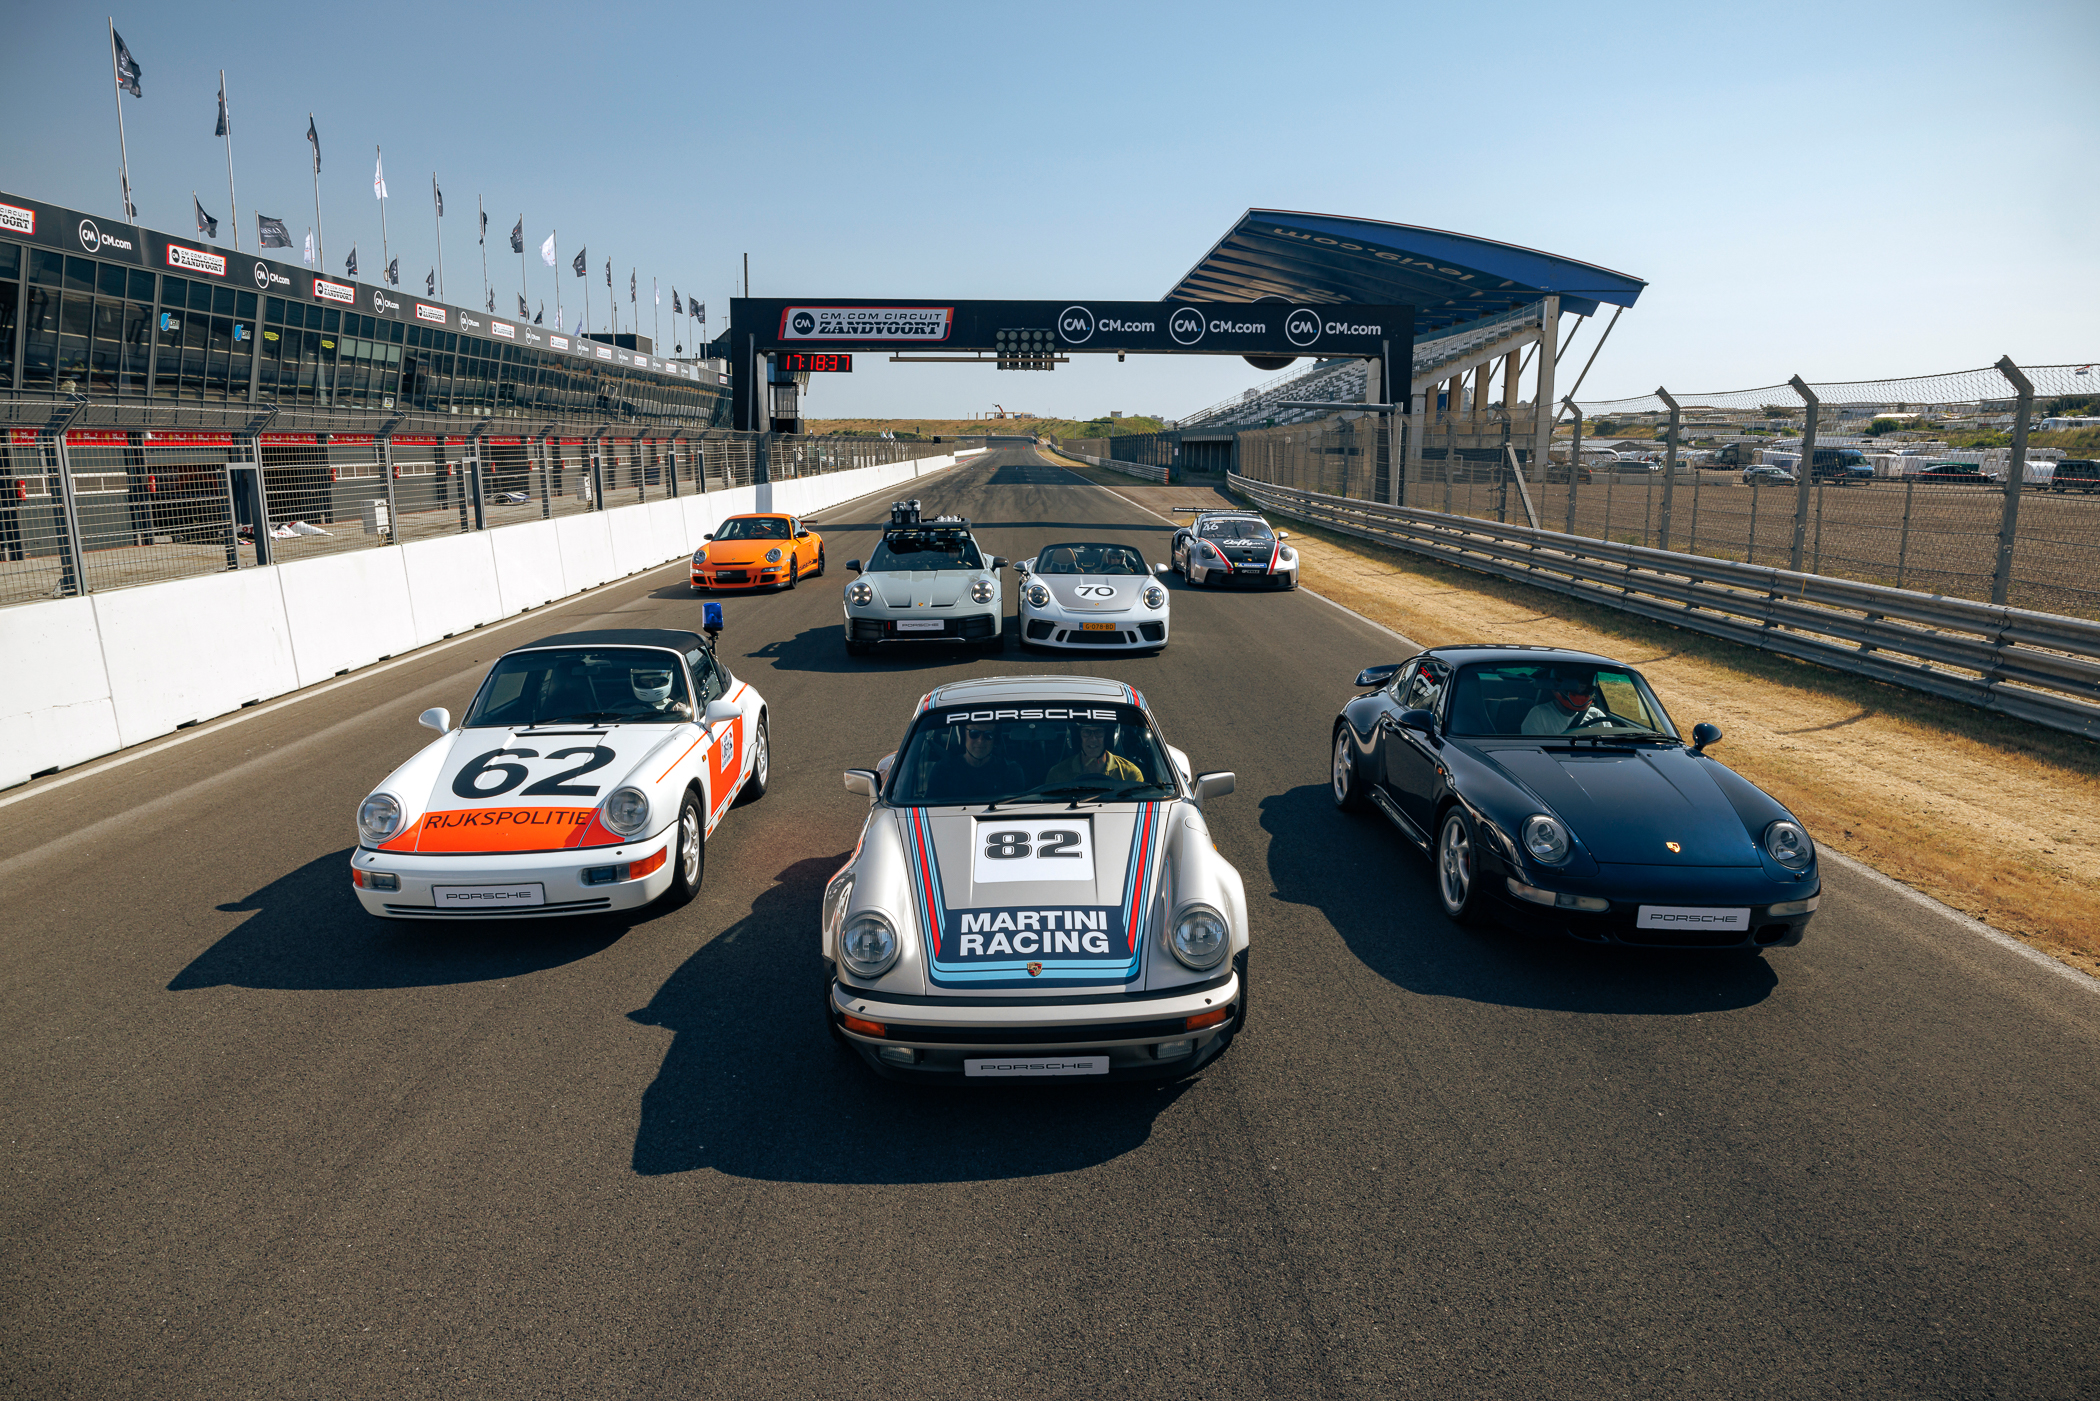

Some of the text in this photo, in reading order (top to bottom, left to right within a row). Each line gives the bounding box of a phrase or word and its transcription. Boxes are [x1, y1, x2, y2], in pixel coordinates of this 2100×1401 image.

[0, 213, 30, 230] OORT
[101, 233, 132, 250] CM.com
[1273, 226, 1476, 282] levi9.com
[820, 312, 942, 321] CM.COM CIRCUIT
[818, 321, 941, 335] ZANDVOORT
[1098, 319, 1155, 332] CM.com
[1209, 320, 1266, 334] CM.com
[1325, 322, 1382, 336] CM.com
[786, 354, 850, 371] 17:18:37
[1203, 523, 1219, 531] 46
[1078, 586, 1115, 597] 70
[946, 709, 1117, 724] PORSCHE
[452, 746, 616, 799] 62
[424, 810, 591, 831] RIJKSPOLITIE
[984, 830, 1083, 860] 82
[446, 890, 532, 901] PORSCHE
[960, 910, 1108, 934] MARTINI
[1650, 913, 1738, 923] PORSCHE
[959, 931, 1110, 957] RACING
[980, 1062, 1094, 1071] PORSCHE
